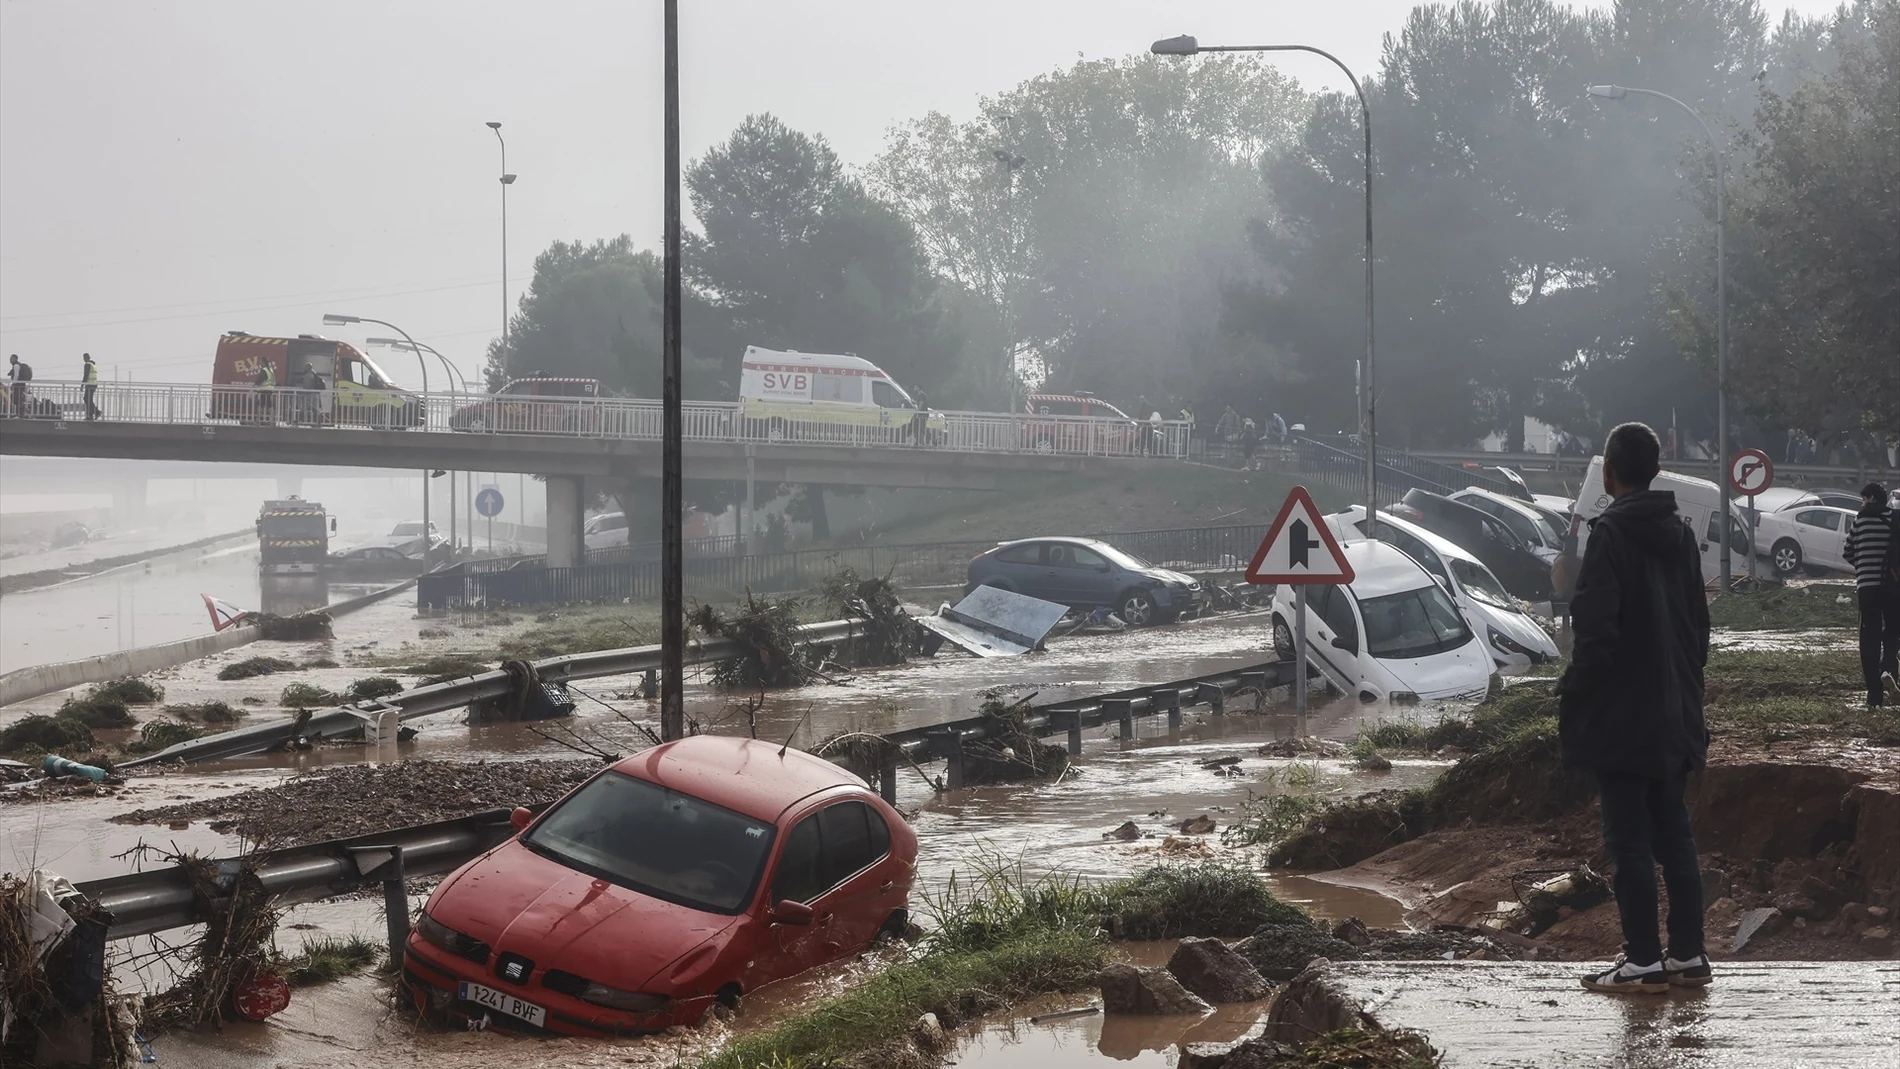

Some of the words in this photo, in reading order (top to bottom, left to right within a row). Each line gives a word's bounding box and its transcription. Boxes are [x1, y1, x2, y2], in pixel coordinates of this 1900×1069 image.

[763, 373, 807, 390] SVB
[473, 985, 507, 1010] 1241
[512, 999, 539, 1021] BVF
